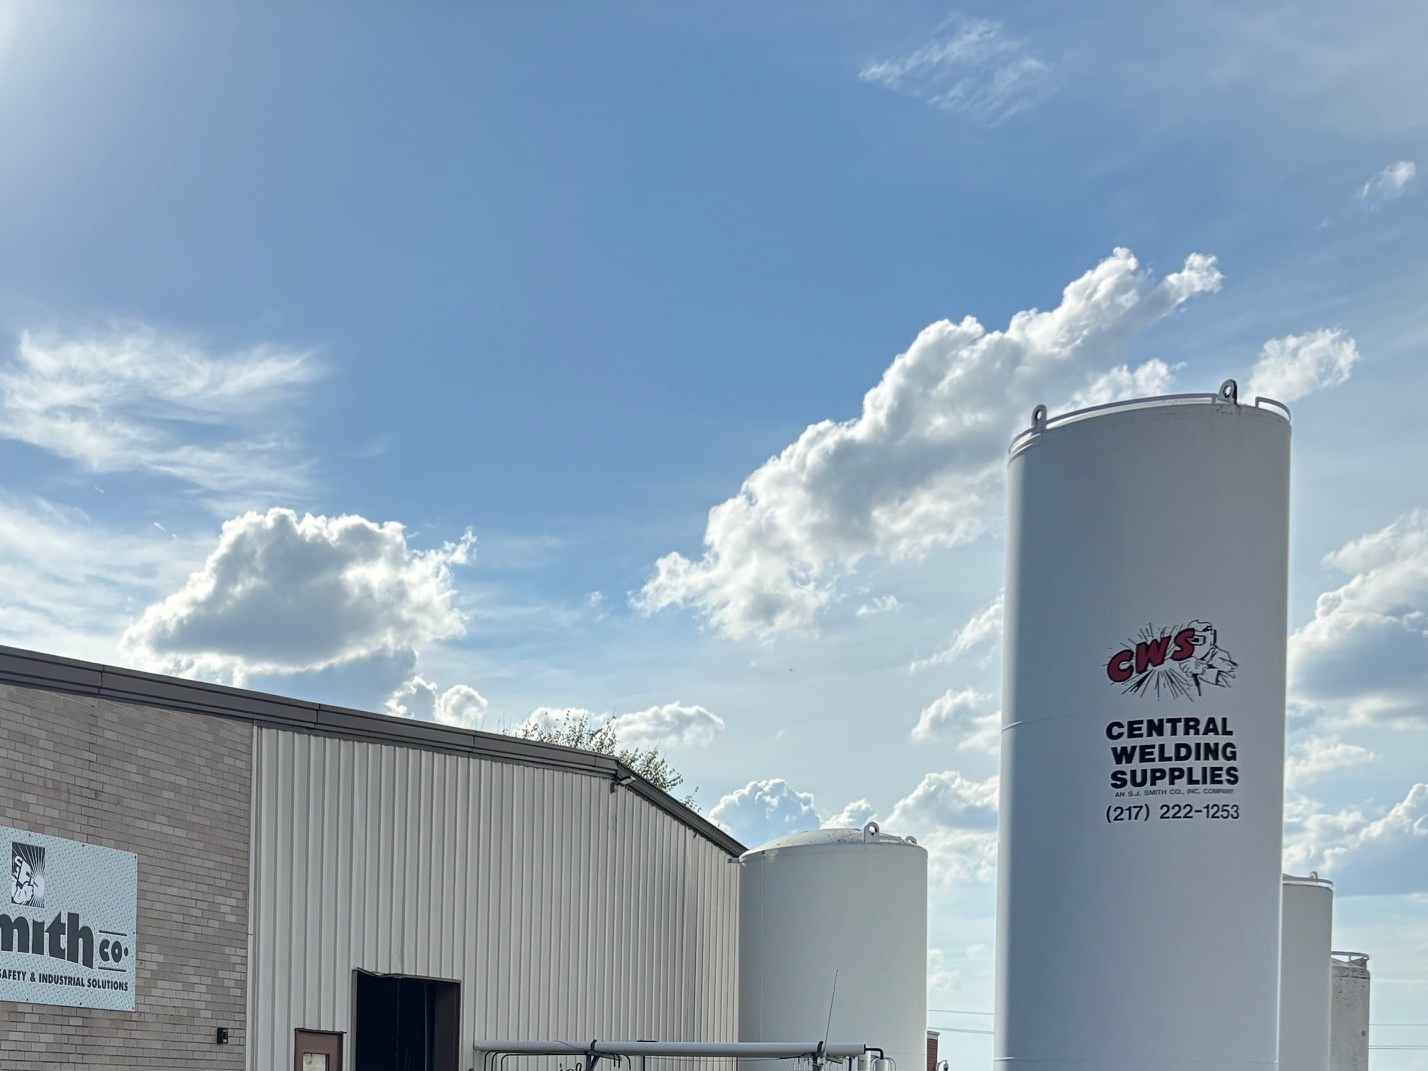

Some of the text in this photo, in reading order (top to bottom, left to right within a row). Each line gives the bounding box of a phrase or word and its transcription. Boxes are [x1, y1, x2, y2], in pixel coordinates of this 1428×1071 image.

[1106, 628, 1195, 682] CWS
[1105, 717, 1234, 741] CENTRAL
[1110, 742, 1237, 765] WELDING
[1110, 766, 1239, 789] SUPPLIES
[1106, 803, 1240, 823] (217) 222-1253
[29, 972, 36, 983] &
[38, 973, 86, 988] INDUSTRIAL
[87, 977, 129, 992] SOLUTIONS
